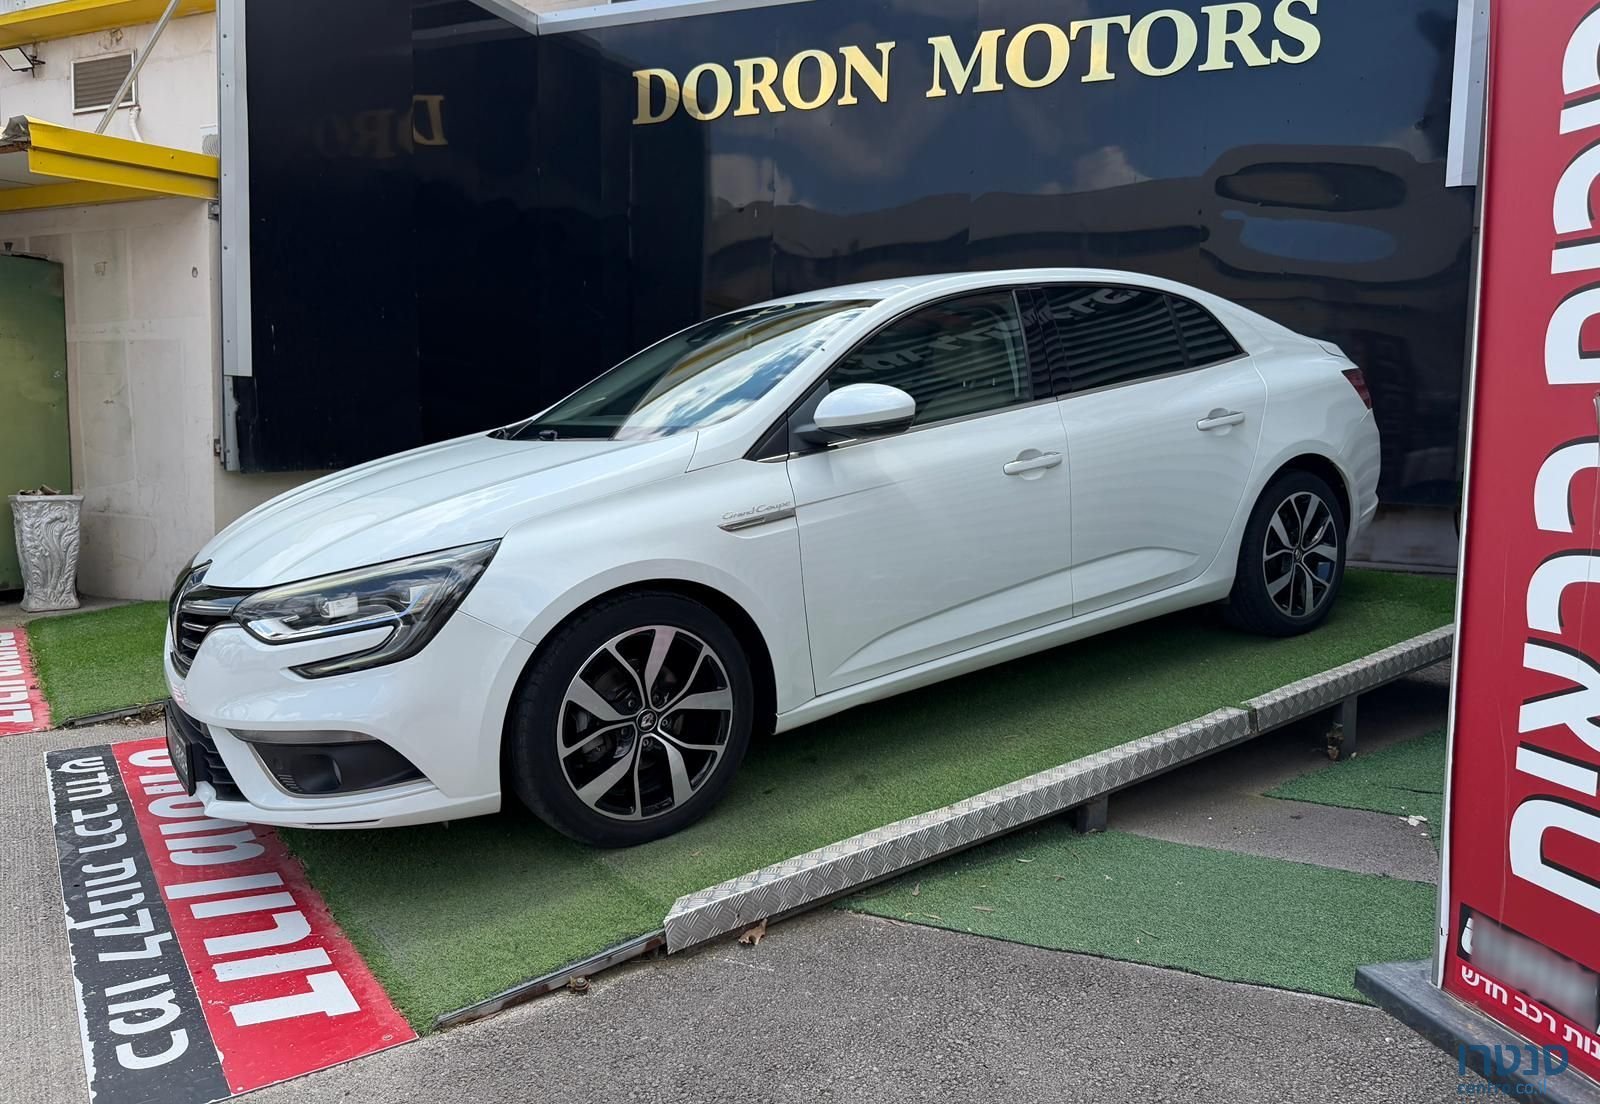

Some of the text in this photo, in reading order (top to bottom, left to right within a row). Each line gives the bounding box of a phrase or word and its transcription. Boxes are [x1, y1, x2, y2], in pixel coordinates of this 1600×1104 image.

[631, 0, 1321, 126] DORON MOTORS
[722, 506, 755, 520] Grand
[56, 756, 189, 1070] כמו לקנות רכב חדש
[164, 872, 361, 1027] דורון
[1461, 965, 1508, 1005] חדש
[1513, 996, 1556, 1034] רכב
